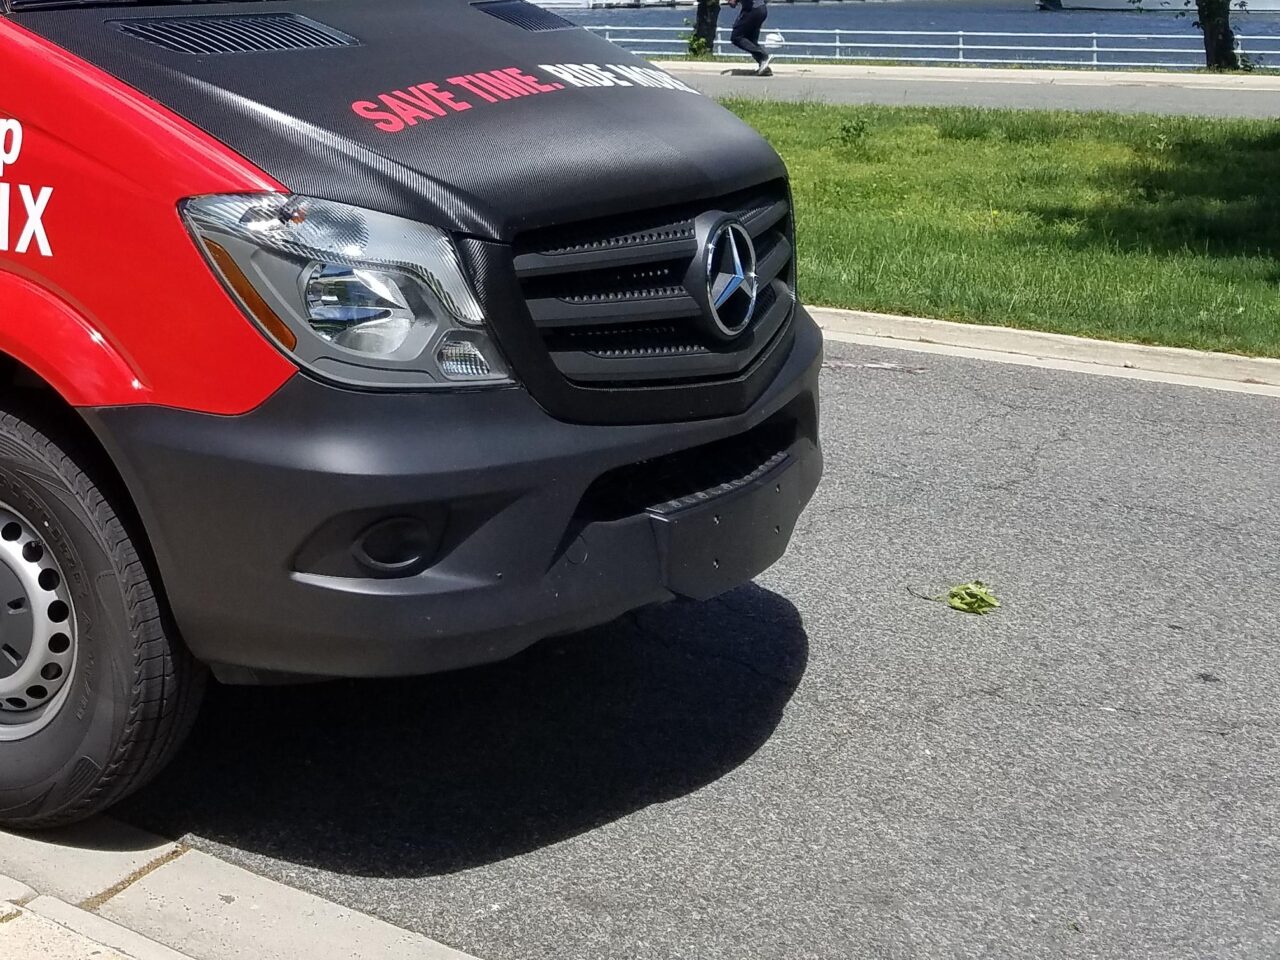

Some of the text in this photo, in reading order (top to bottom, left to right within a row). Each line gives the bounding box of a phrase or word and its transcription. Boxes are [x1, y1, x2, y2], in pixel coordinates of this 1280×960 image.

[352, 81, 473, 133] SAVE
[446, 66, 566, 104] TIME.
[537, 63, 634, 88] RIDE
